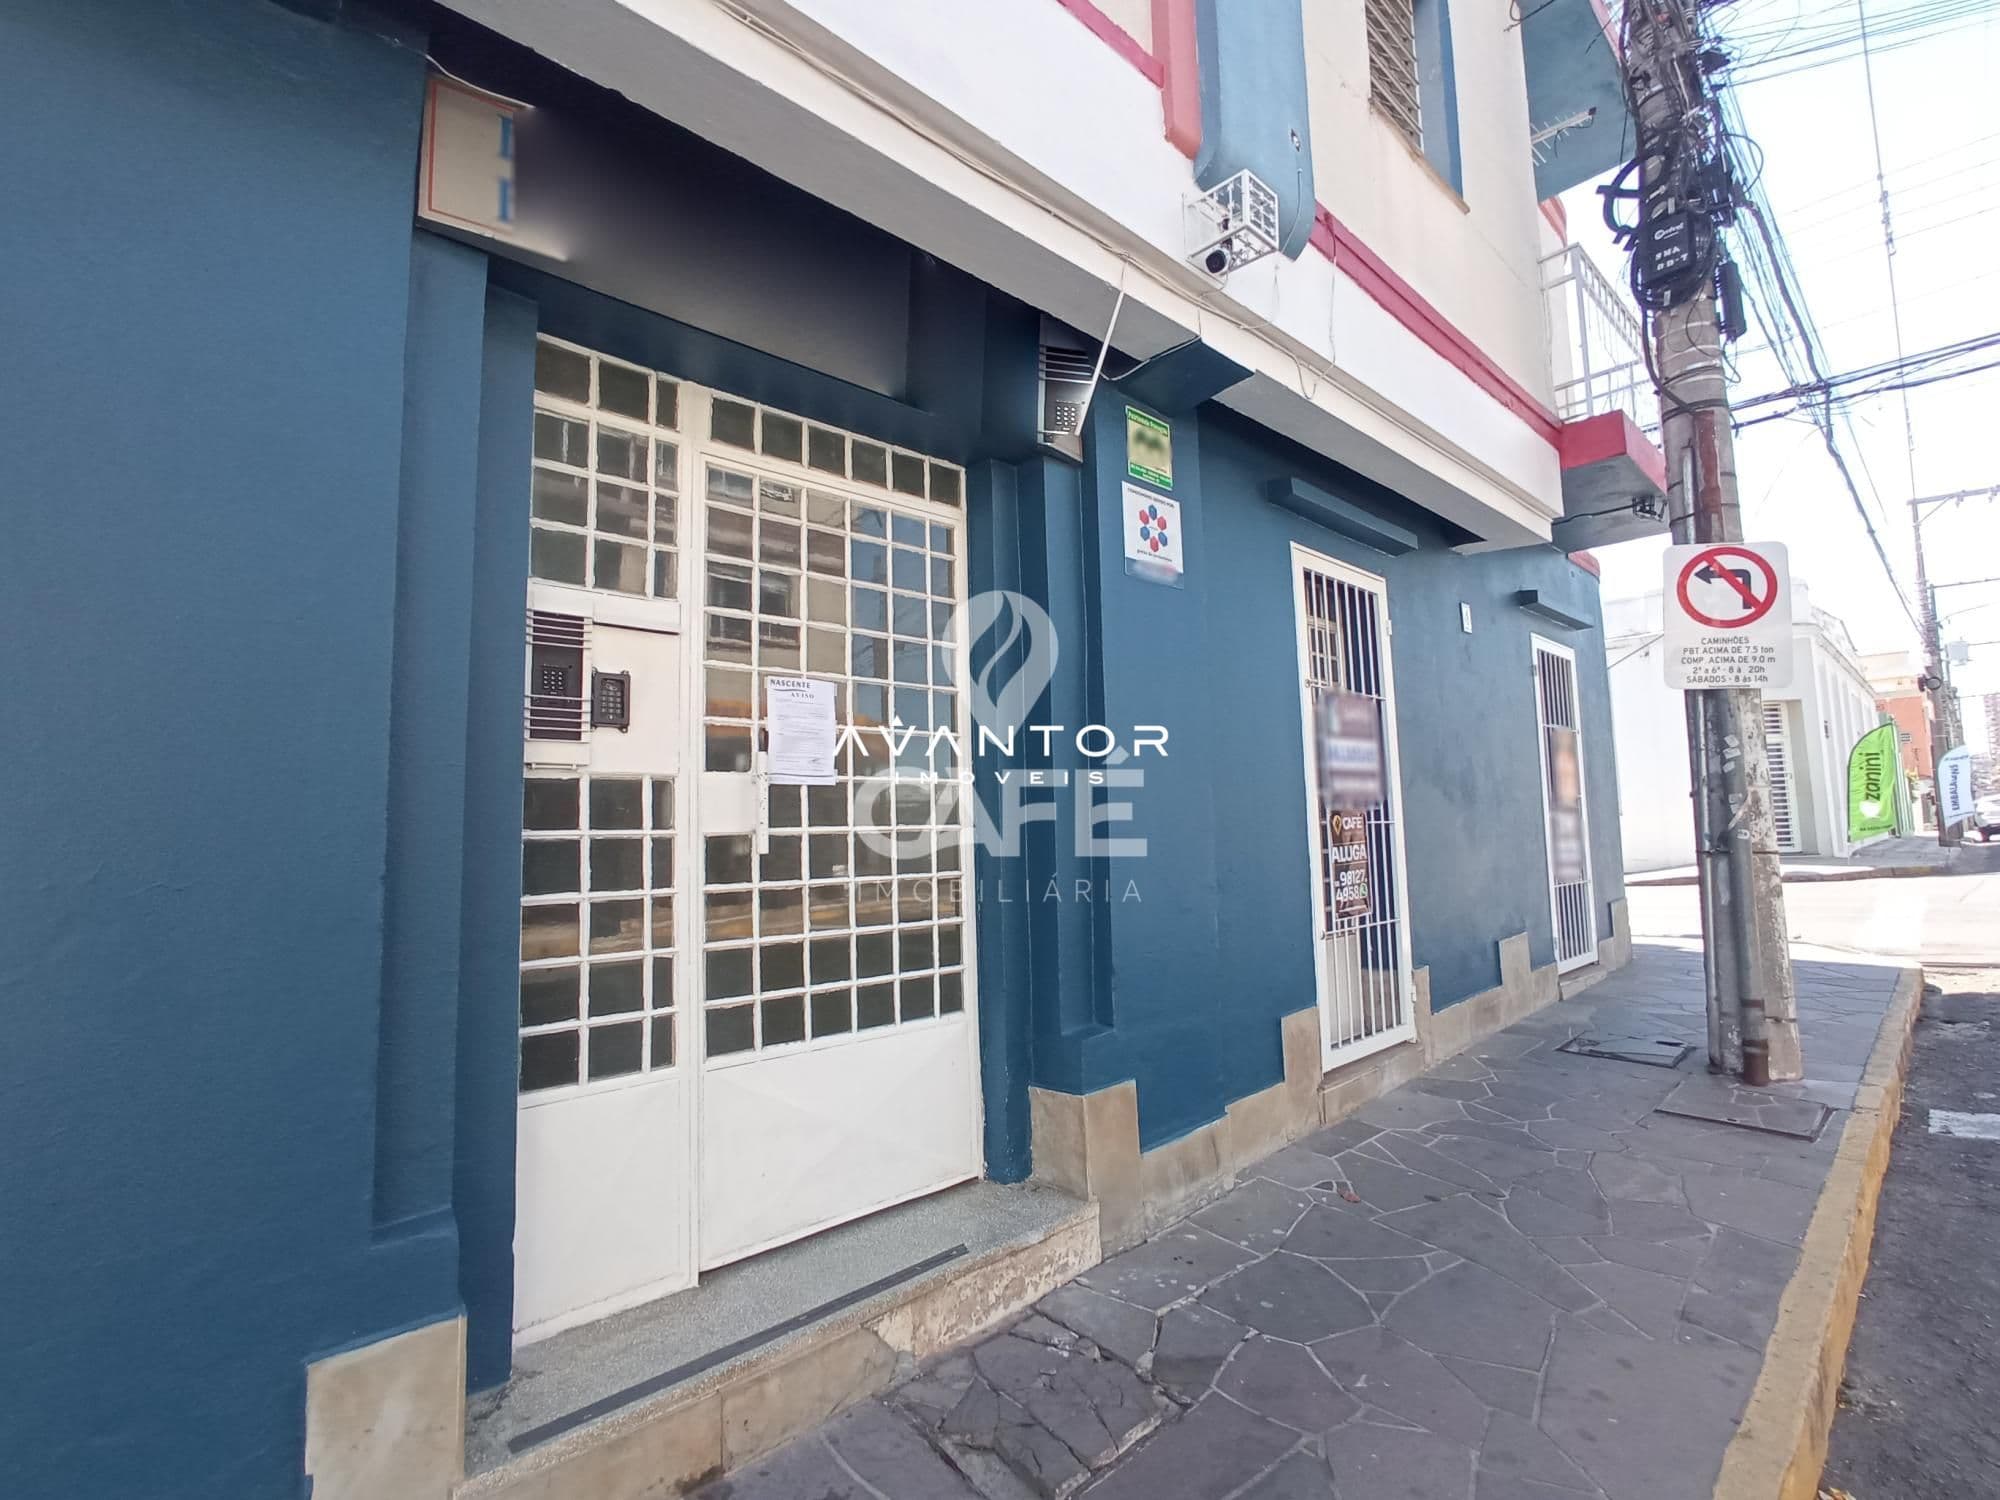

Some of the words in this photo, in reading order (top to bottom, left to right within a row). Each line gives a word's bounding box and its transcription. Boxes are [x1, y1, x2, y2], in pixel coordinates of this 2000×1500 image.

[1701, 636, 1750, 645] CAMINHÕES
[1683, 647, 1699, 655] PBT
[1702, 646, 1729, 654] ACIMA
[1737, 656, 1750, 664] DE
[1728, 666, 1734, 674] 8
[1748, 666, 1766, 674] 20h
[1734, 674, 1740, 682] 8
[1754, 674, 1768, 682] 14h
[770, 679, 811, 689] NASCENTE
[1859, 752, 1882, 801] zanini
[1342, 813, 1364, 830] CAFÉ
[1332, 845, 1367, 862] ALUGA
[1336, 884, 1360, 901] 4958
